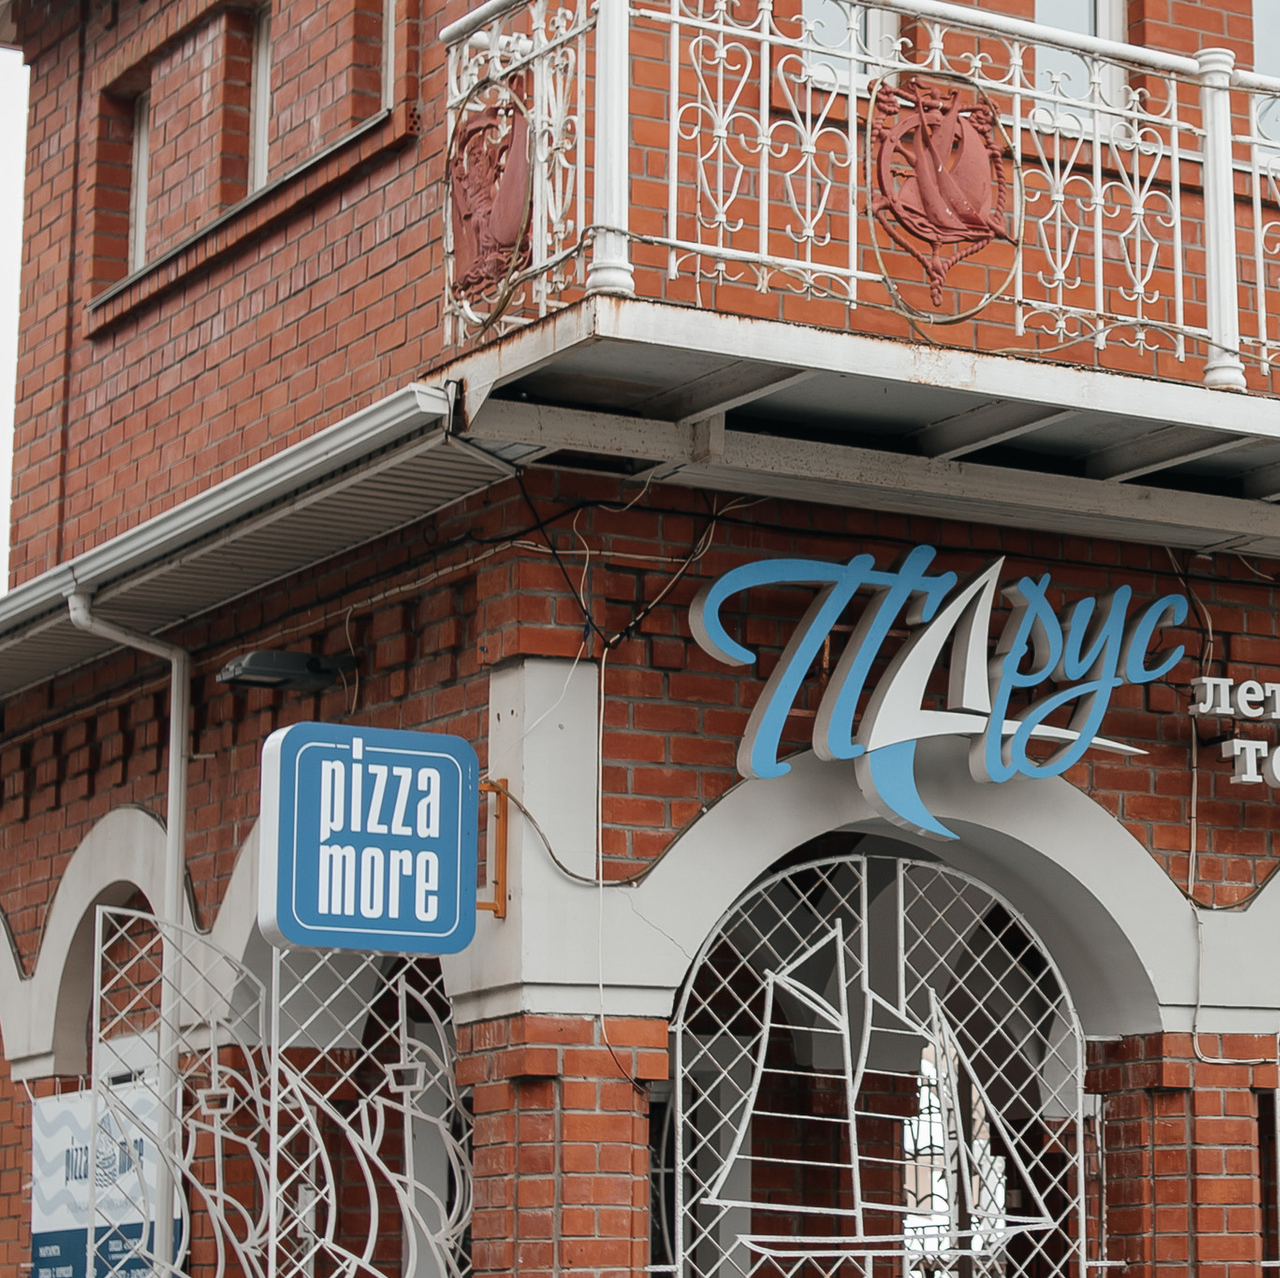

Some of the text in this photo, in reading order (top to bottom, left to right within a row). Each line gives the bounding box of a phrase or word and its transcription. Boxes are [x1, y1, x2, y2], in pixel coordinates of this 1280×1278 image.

[320, 737, 441, 843] pizza
[318, 845, 439, 922] more
[65, 1135, 89, 1186] pizza
